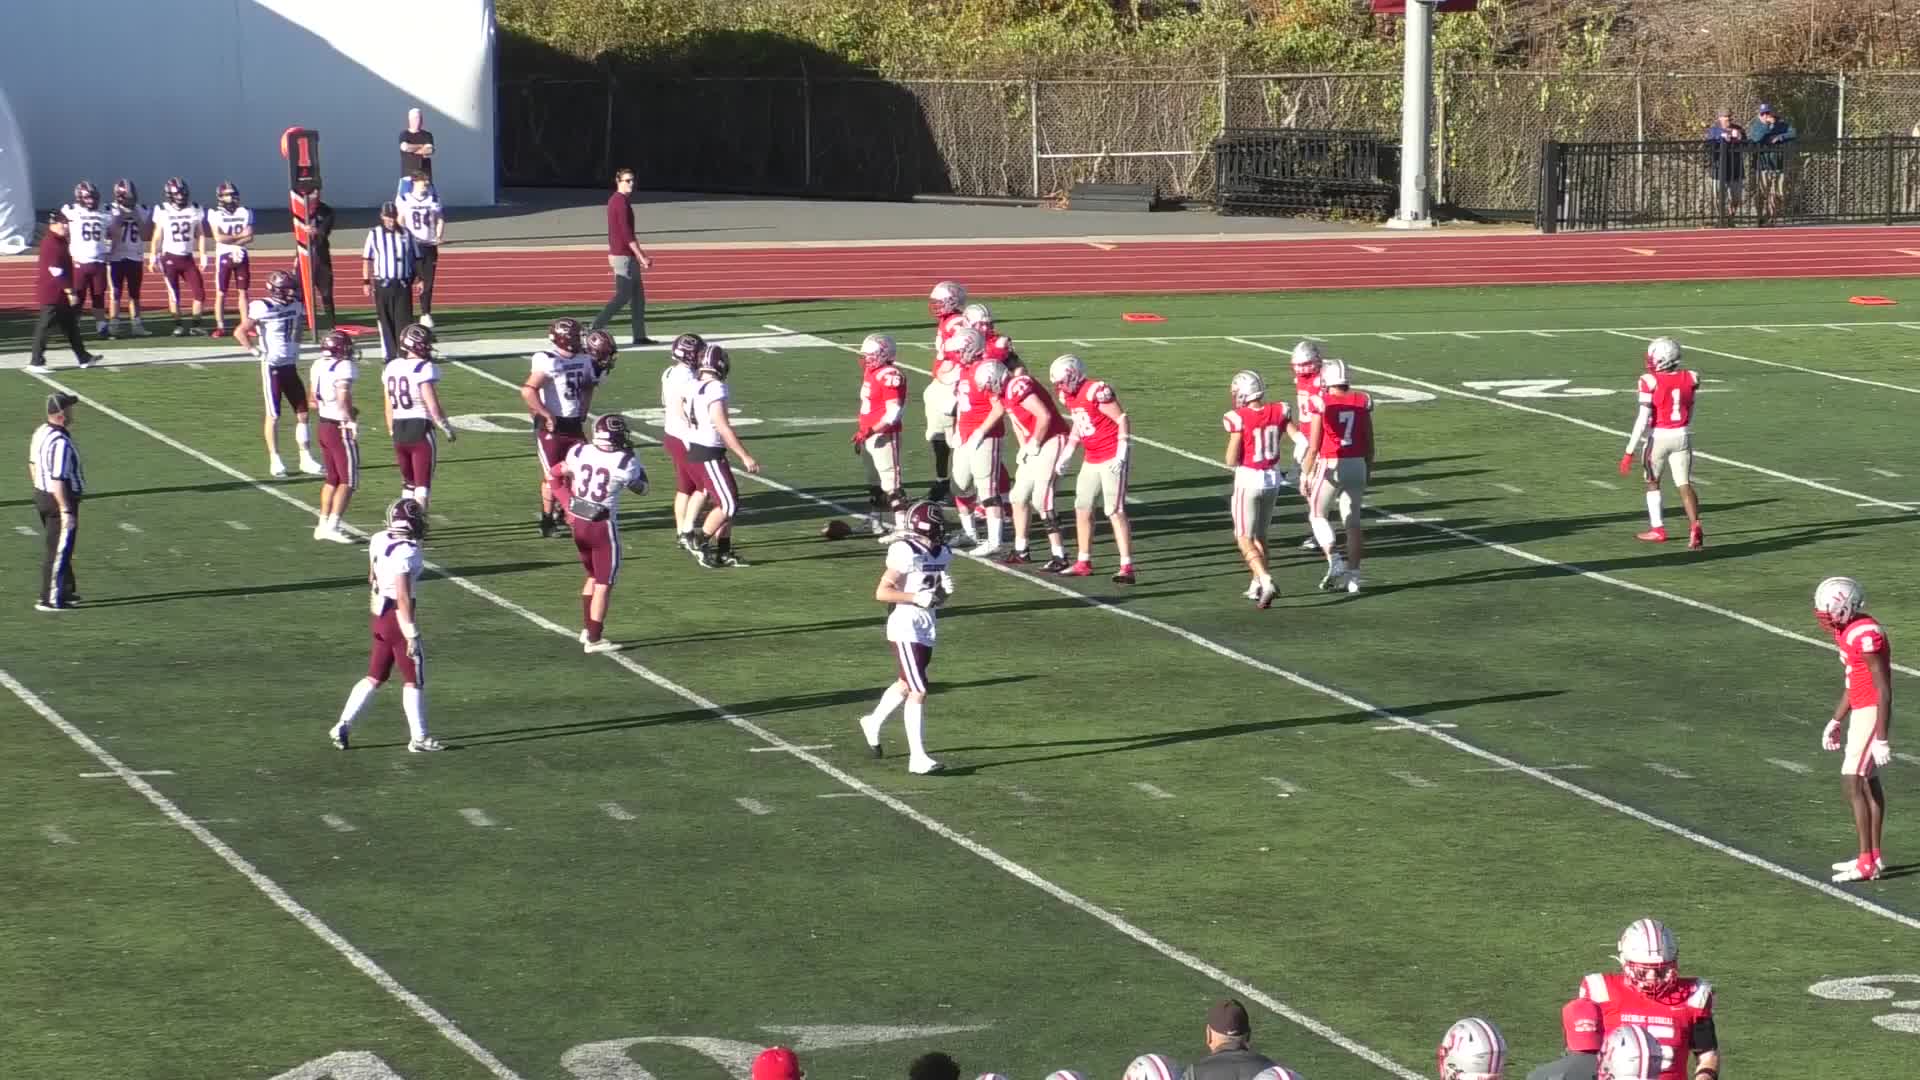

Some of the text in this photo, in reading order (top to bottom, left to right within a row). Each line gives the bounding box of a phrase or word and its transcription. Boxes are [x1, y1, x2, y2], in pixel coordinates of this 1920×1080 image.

[297, 136, 311, 166] 1
[171, 222, 191, 242] 22
[387, 376, 413, 409] 88
[1670, 388, 1682, 421] 1
[1252, 425, 1280, 462] 10
[1338, 411, 1355, 446] 7
[577, 463, 610, 502] 33
